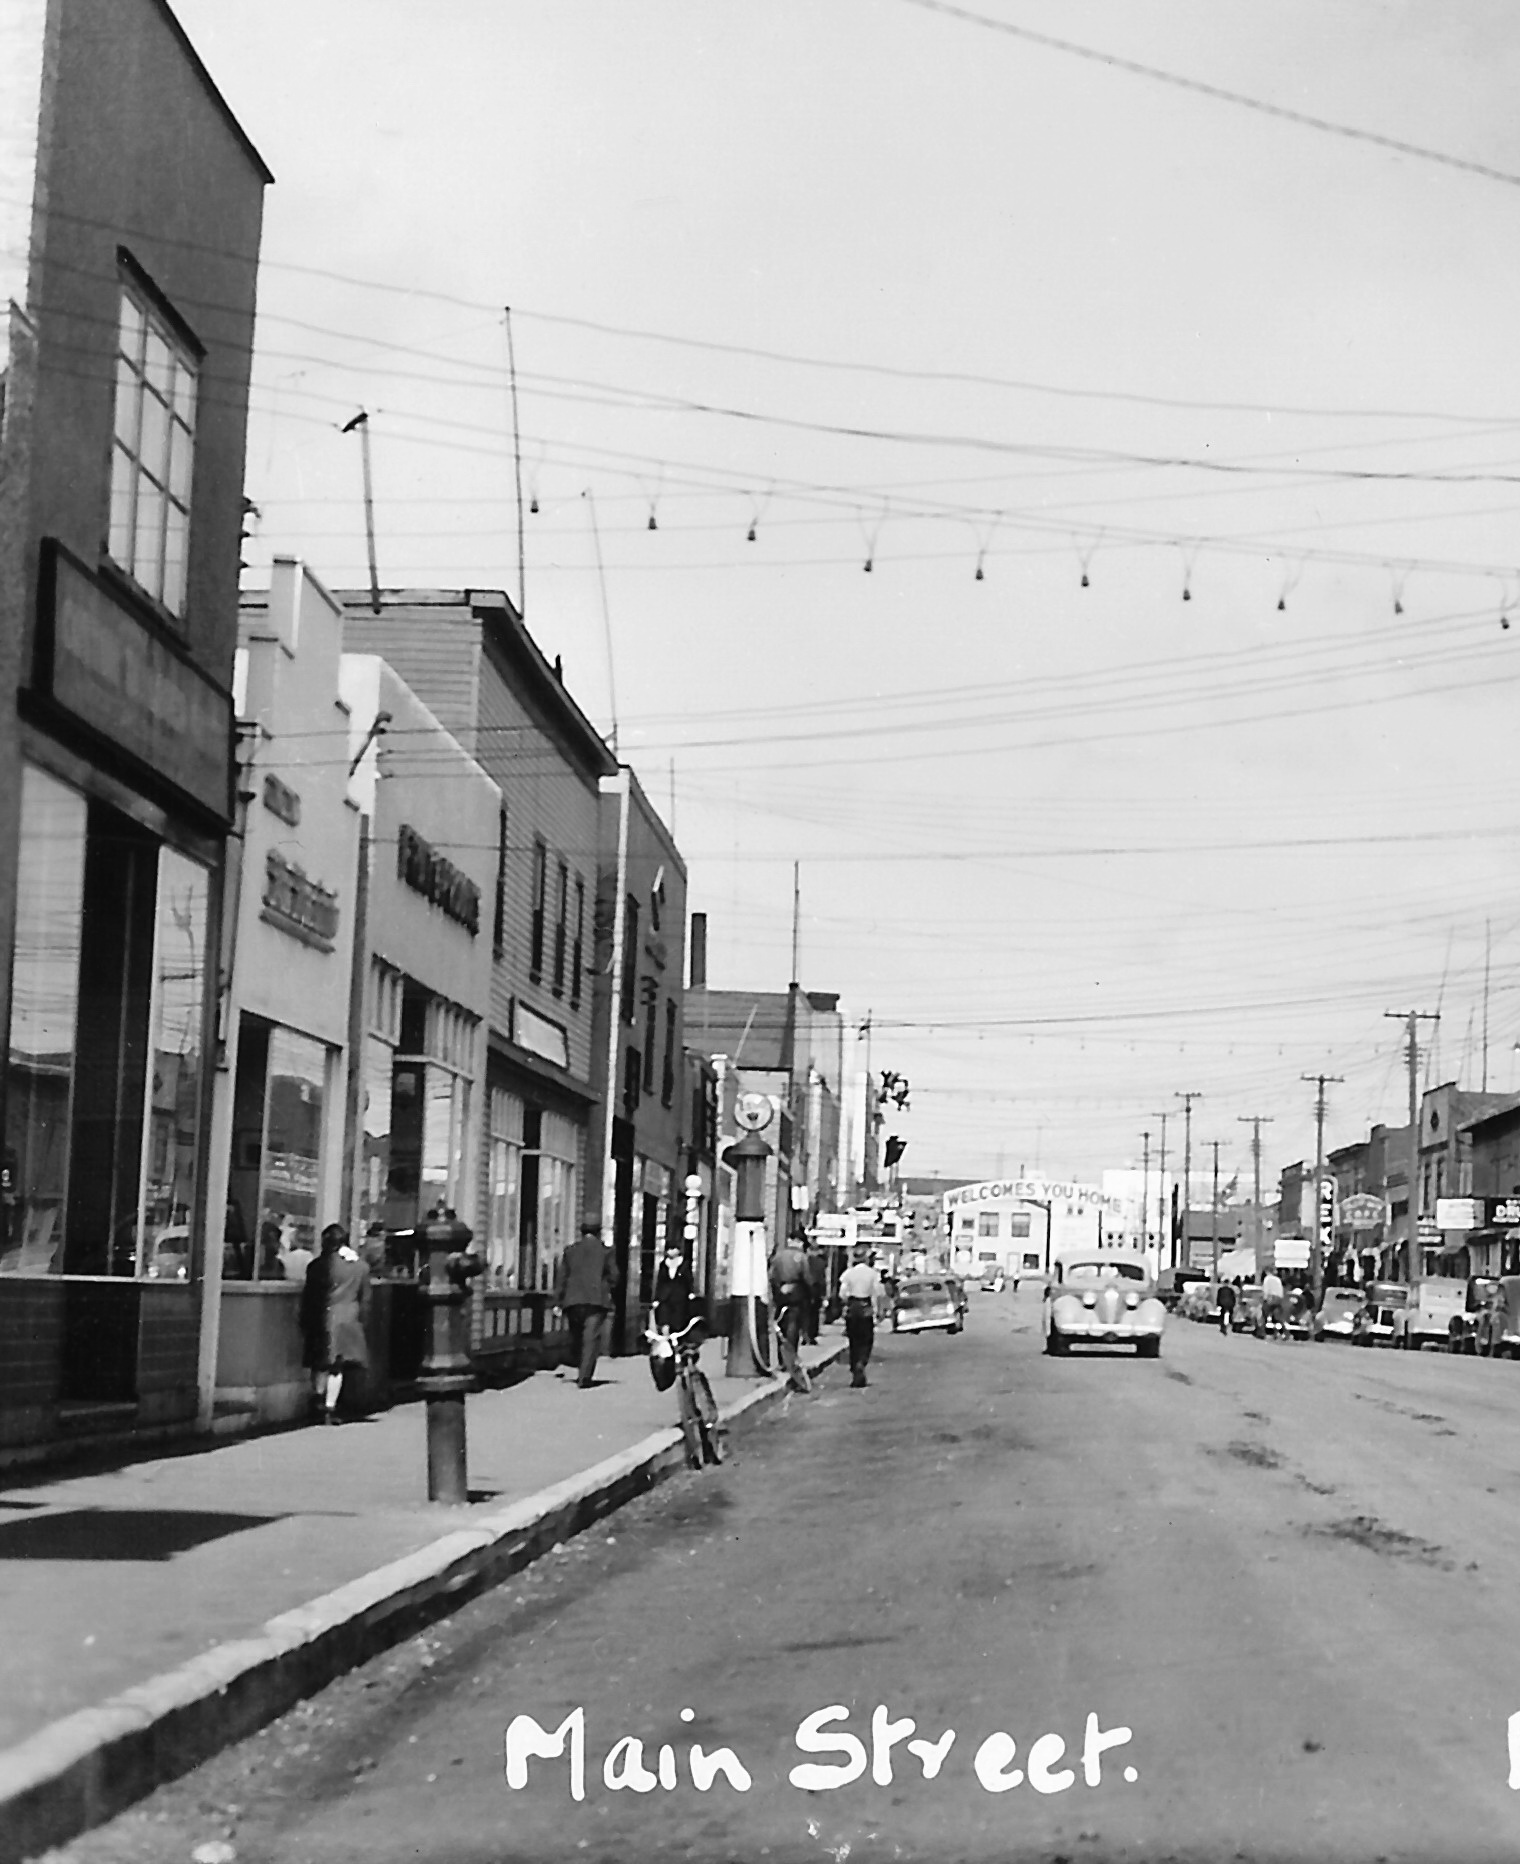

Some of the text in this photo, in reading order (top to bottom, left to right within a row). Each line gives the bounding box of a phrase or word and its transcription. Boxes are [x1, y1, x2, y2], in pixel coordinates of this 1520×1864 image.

[948, 1182, 1122, 1213] WELCOMES YOU HOME
